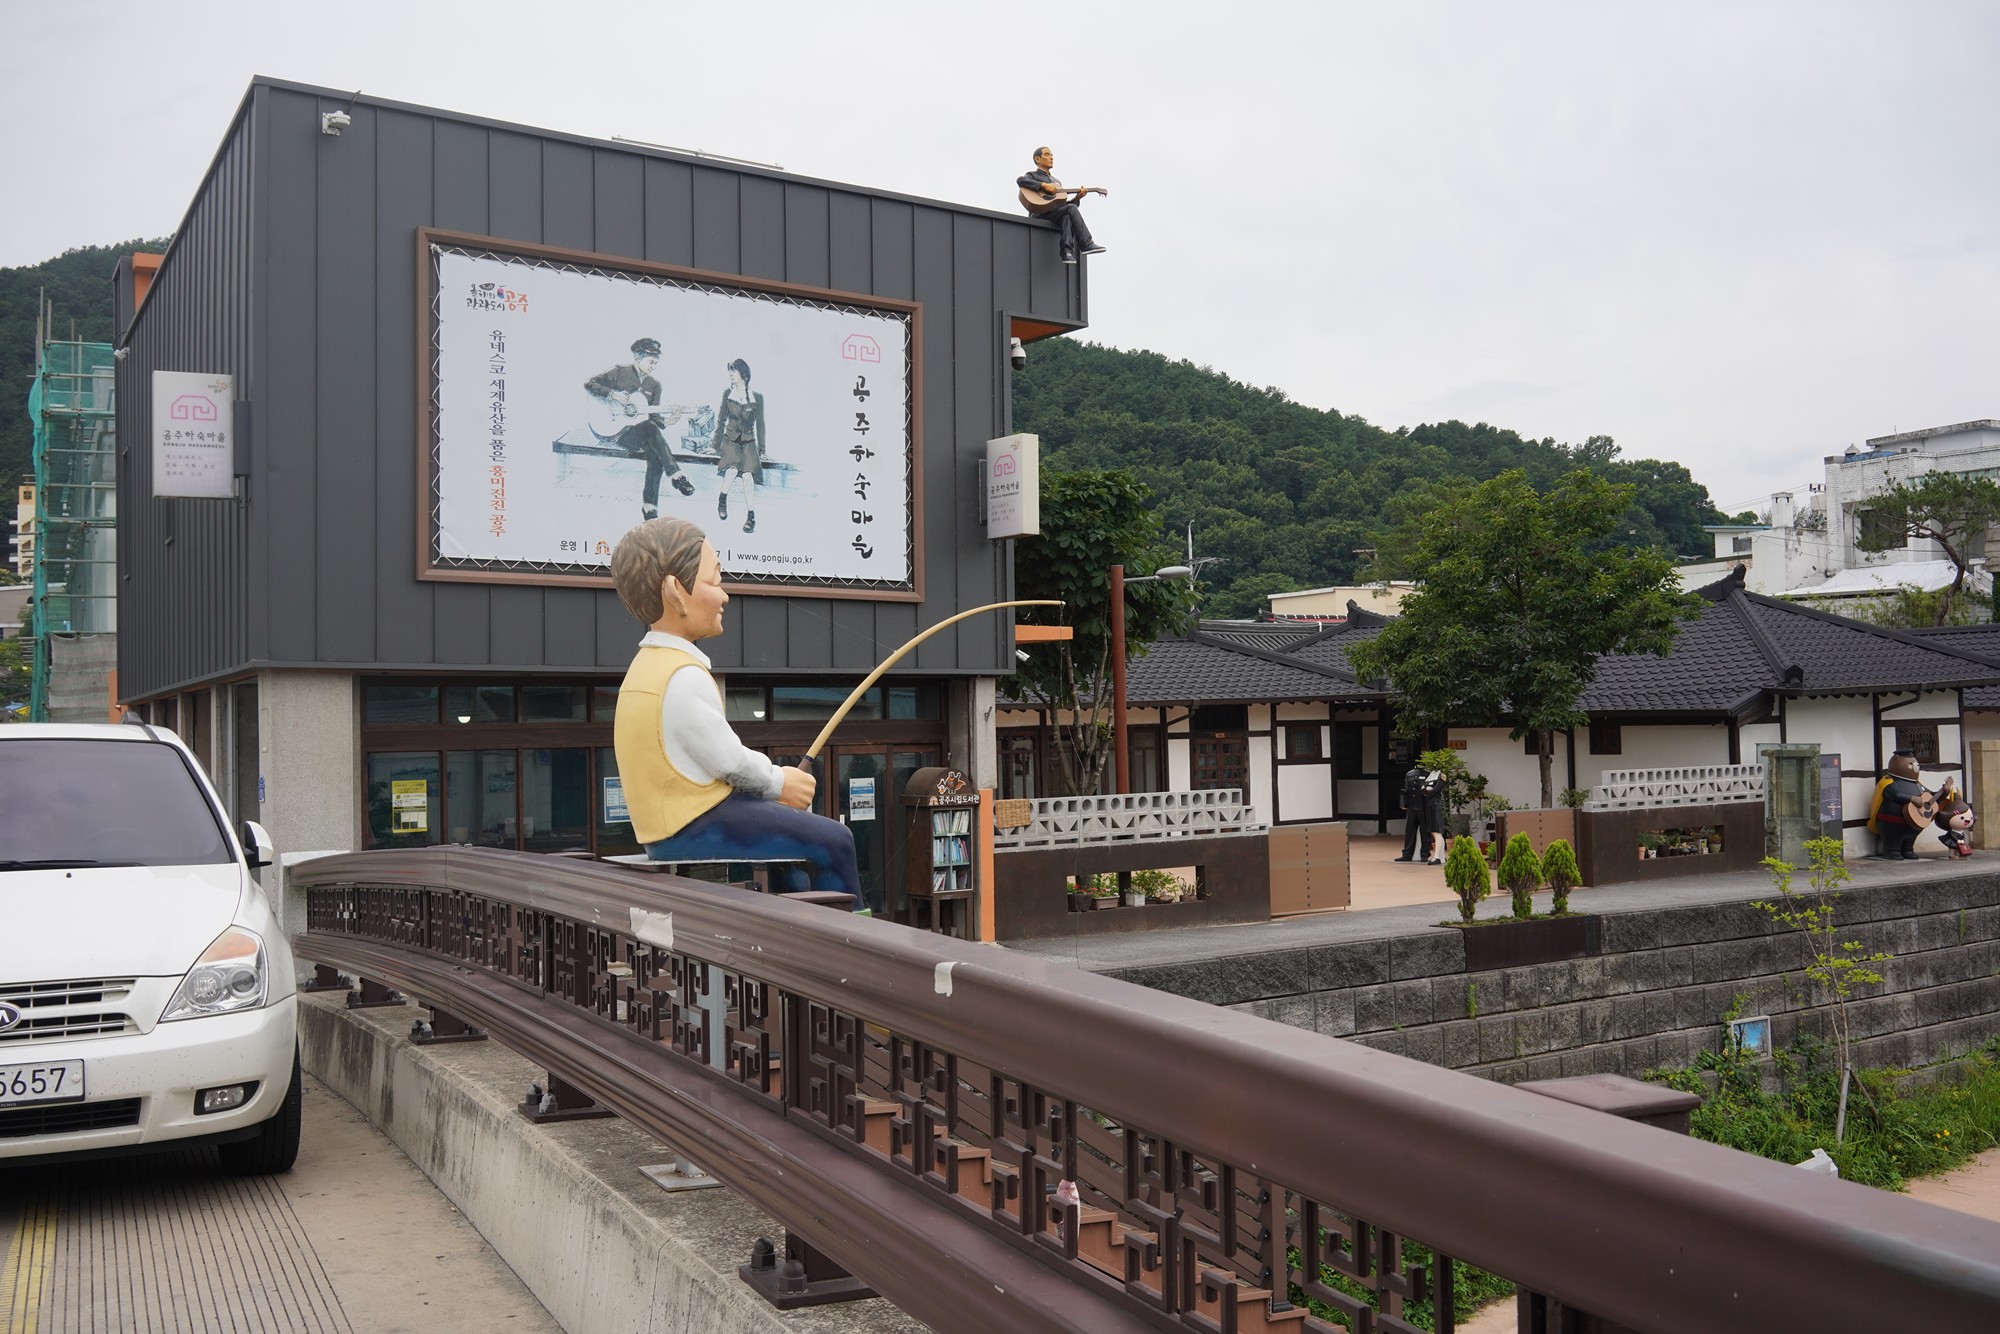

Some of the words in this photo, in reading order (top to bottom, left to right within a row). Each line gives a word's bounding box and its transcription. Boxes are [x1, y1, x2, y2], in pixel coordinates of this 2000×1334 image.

[466, 298, 505, 311] 관광도시
[505, 290, 528, 312] 공주
[488, 329, 506, 375] 유네스코
[488, 379, 506, 436] 세계유산을
[162, 429, 225, 443] 공주하숙마을
[488, 439, 506, 462] 품은
[849, 375, 875, 559] 공주하숙마을
[488, 465, 506, 511] 흥미진진
[488, 514, 506, 537] 공주
[560, 540, 577, 551] 운영
[737, 552, 813, 565] www.gongju.go.kr
[939, 794, 980, 805] 공주시립도서관
